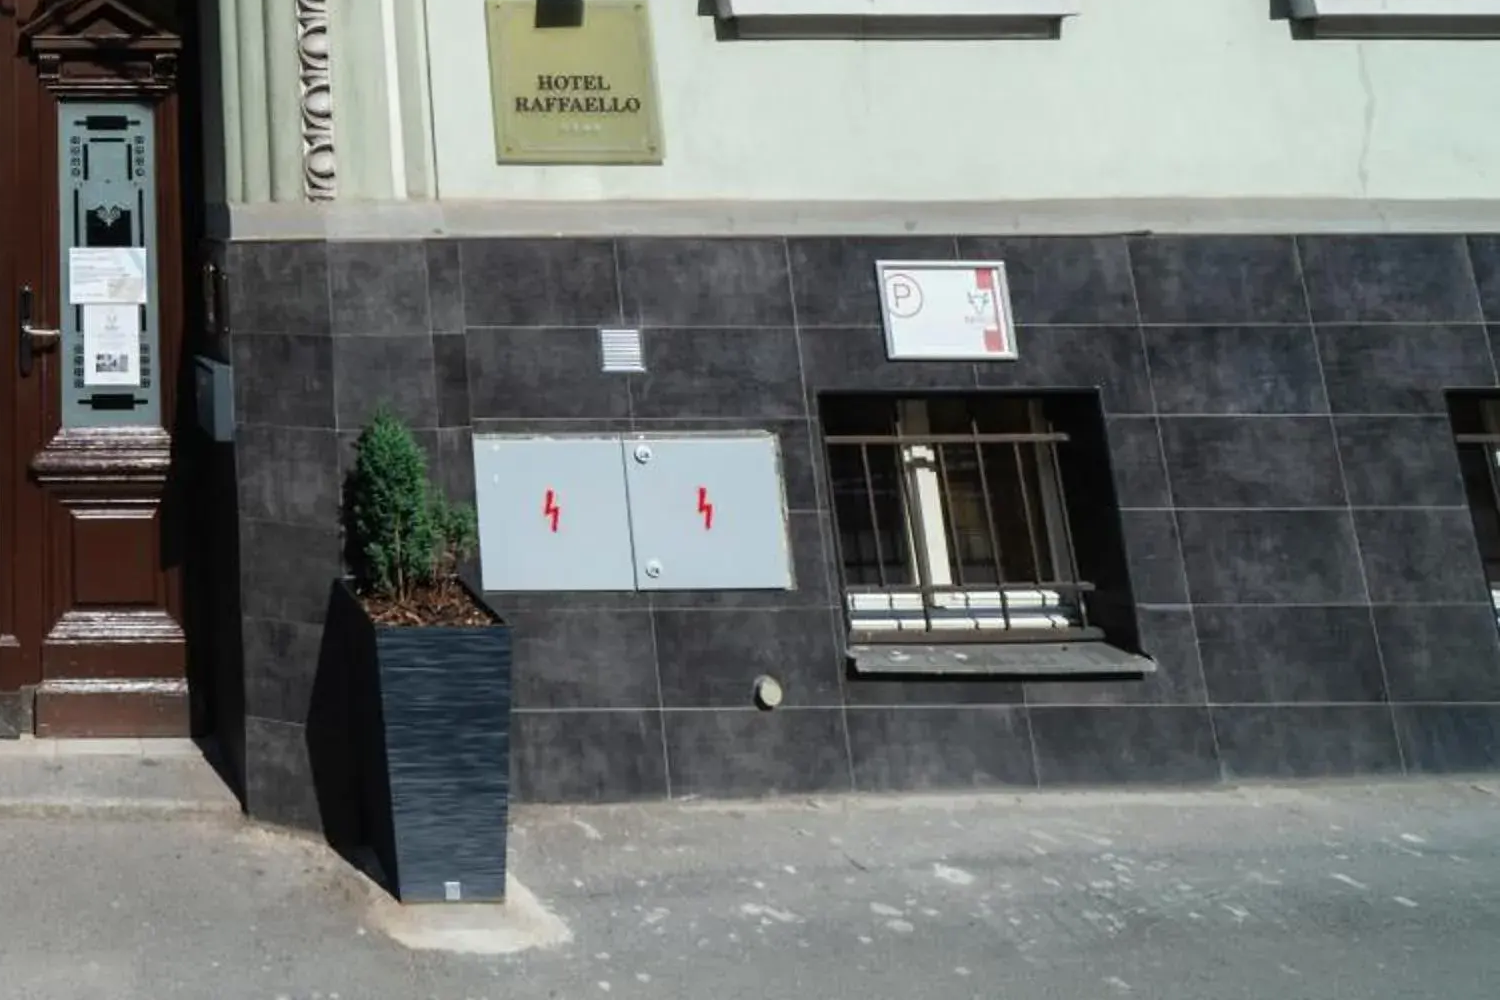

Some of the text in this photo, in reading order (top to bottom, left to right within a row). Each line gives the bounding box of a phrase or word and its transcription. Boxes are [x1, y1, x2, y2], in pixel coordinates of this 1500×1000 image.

[537, 74, 611, 91] HOTEL
[515, 96, 641, 113] RAFFAELLO
[893, 283, 911, 308] P
